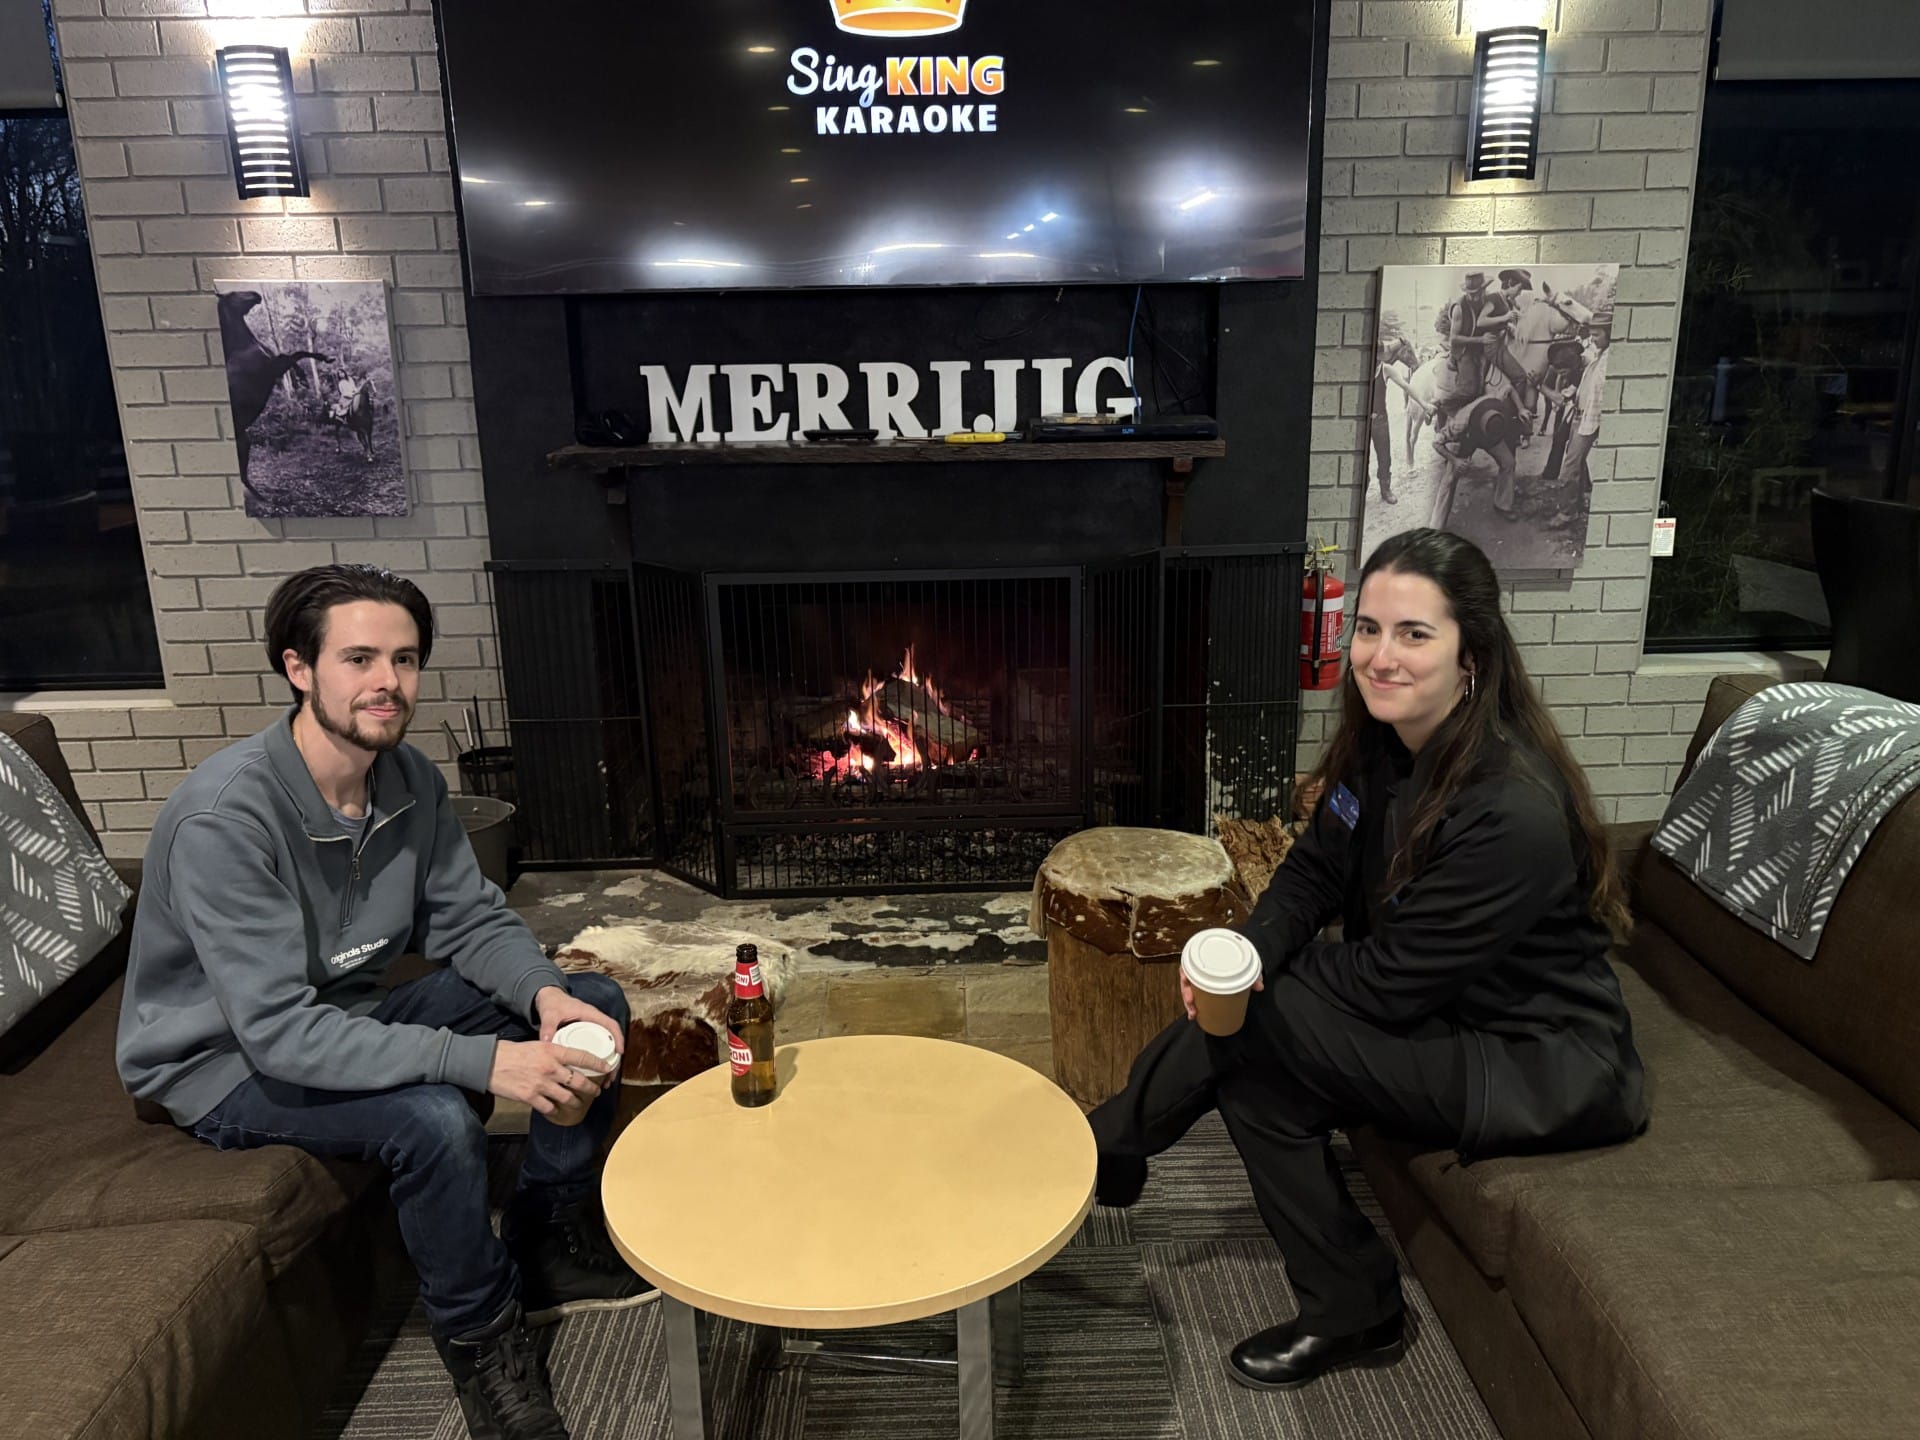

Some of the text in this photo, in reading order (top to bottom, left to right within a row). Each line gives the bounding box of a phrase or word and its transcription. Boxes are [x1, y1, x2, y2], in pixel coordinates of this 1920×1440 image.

[786, 47, 1005, 108] Sing KING
[816, 104, 997, 135] KARAOKE
[639, 355, 1142, 443] MERRIJIG
[361, 937, 389, 953] Studio
